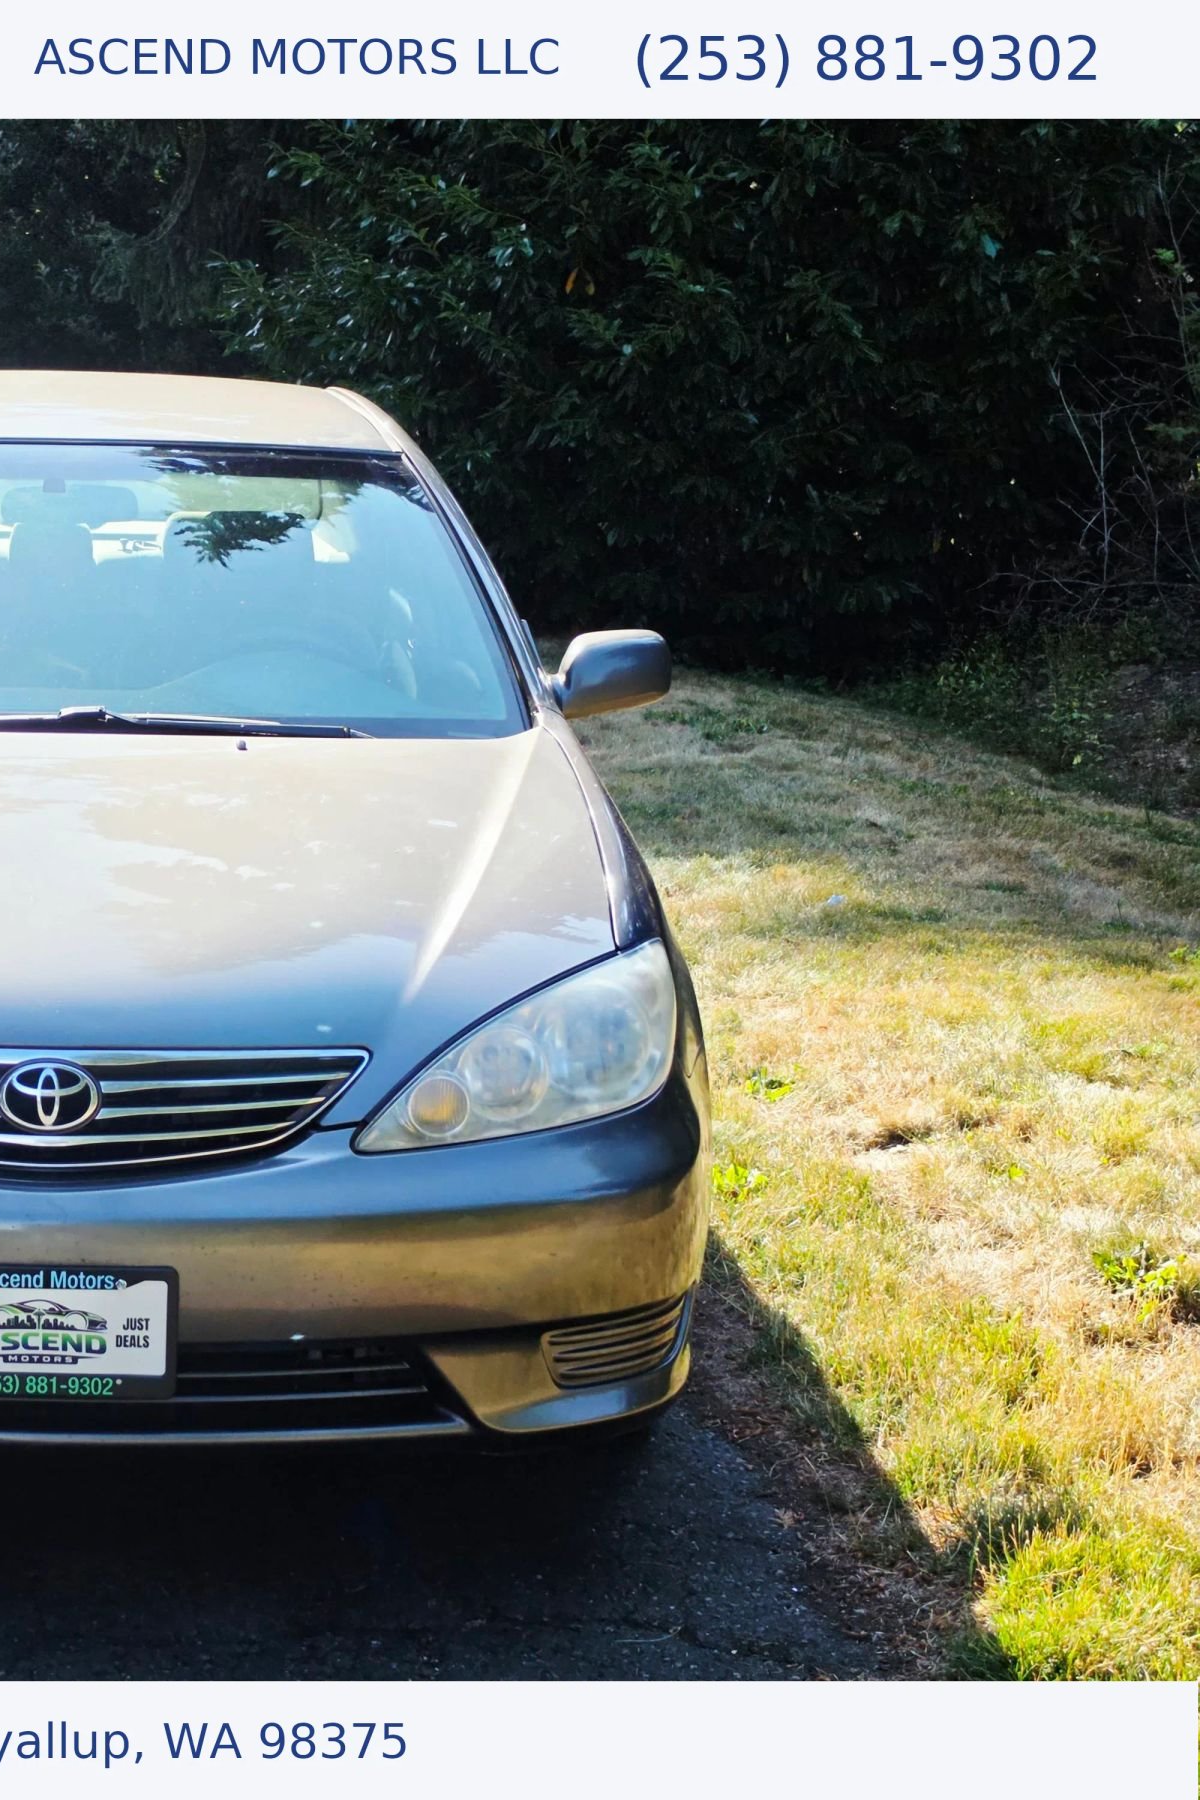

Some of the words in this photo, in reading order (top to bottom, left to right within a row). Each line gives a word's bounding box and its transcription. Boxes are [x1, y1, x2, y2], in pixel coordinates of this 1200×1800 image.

[50, 1271, 115, 1290] Motors
[122, 1318, 150, 1331] JUST
[115, 1334, 150, 1348] DEALS
[8, 1354, 73, 1363] MOTORS
[25, 1376, 113, 1396] 881-9302
